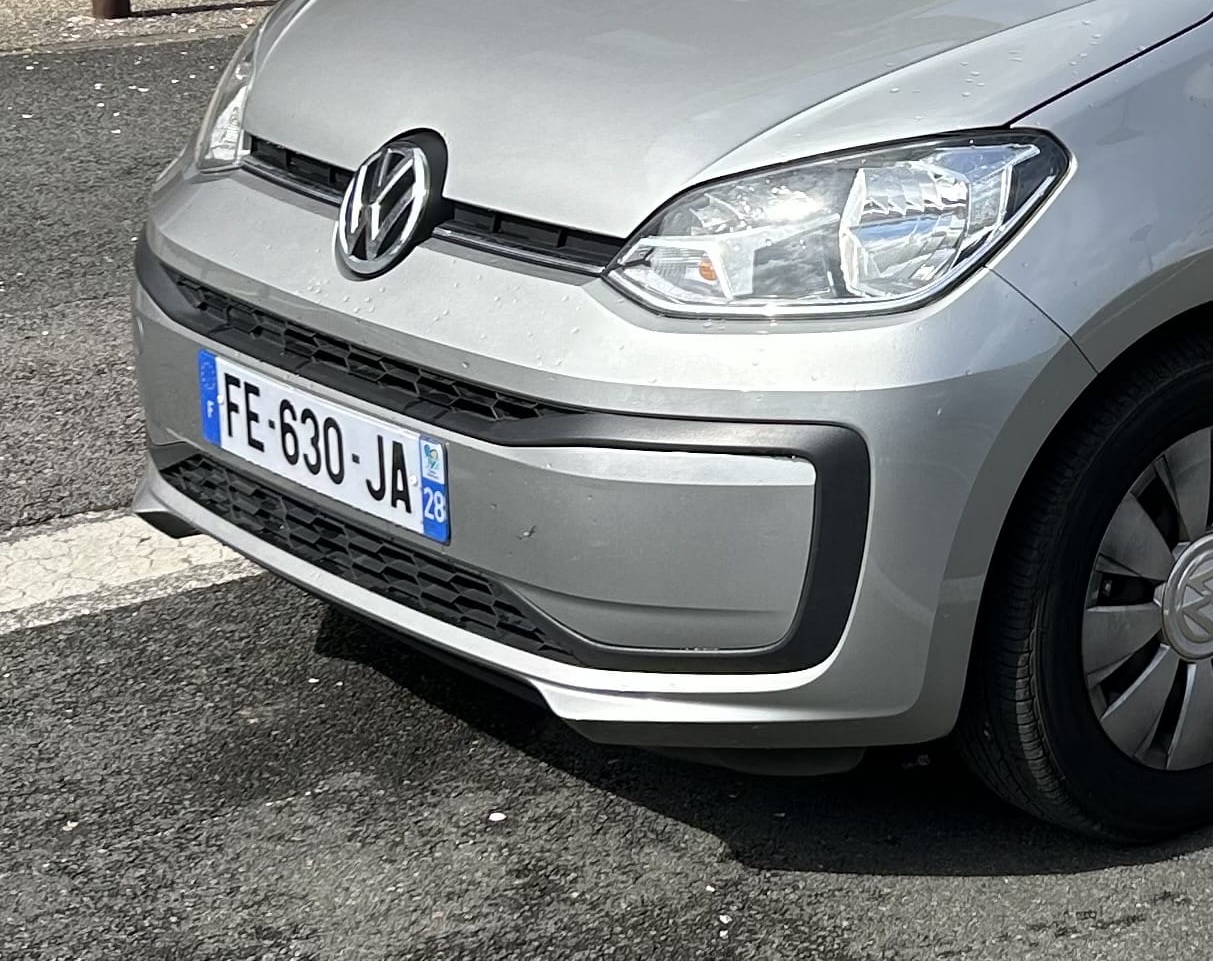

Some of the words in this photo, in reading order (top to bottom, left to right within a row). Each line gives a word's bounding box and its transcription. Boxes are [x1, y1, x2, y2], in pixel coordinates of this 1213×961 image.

[206, 400, 214, 418] F
[223, 372, 413, 514] FE-630-JA
[423, 487, 446, 523] 28
